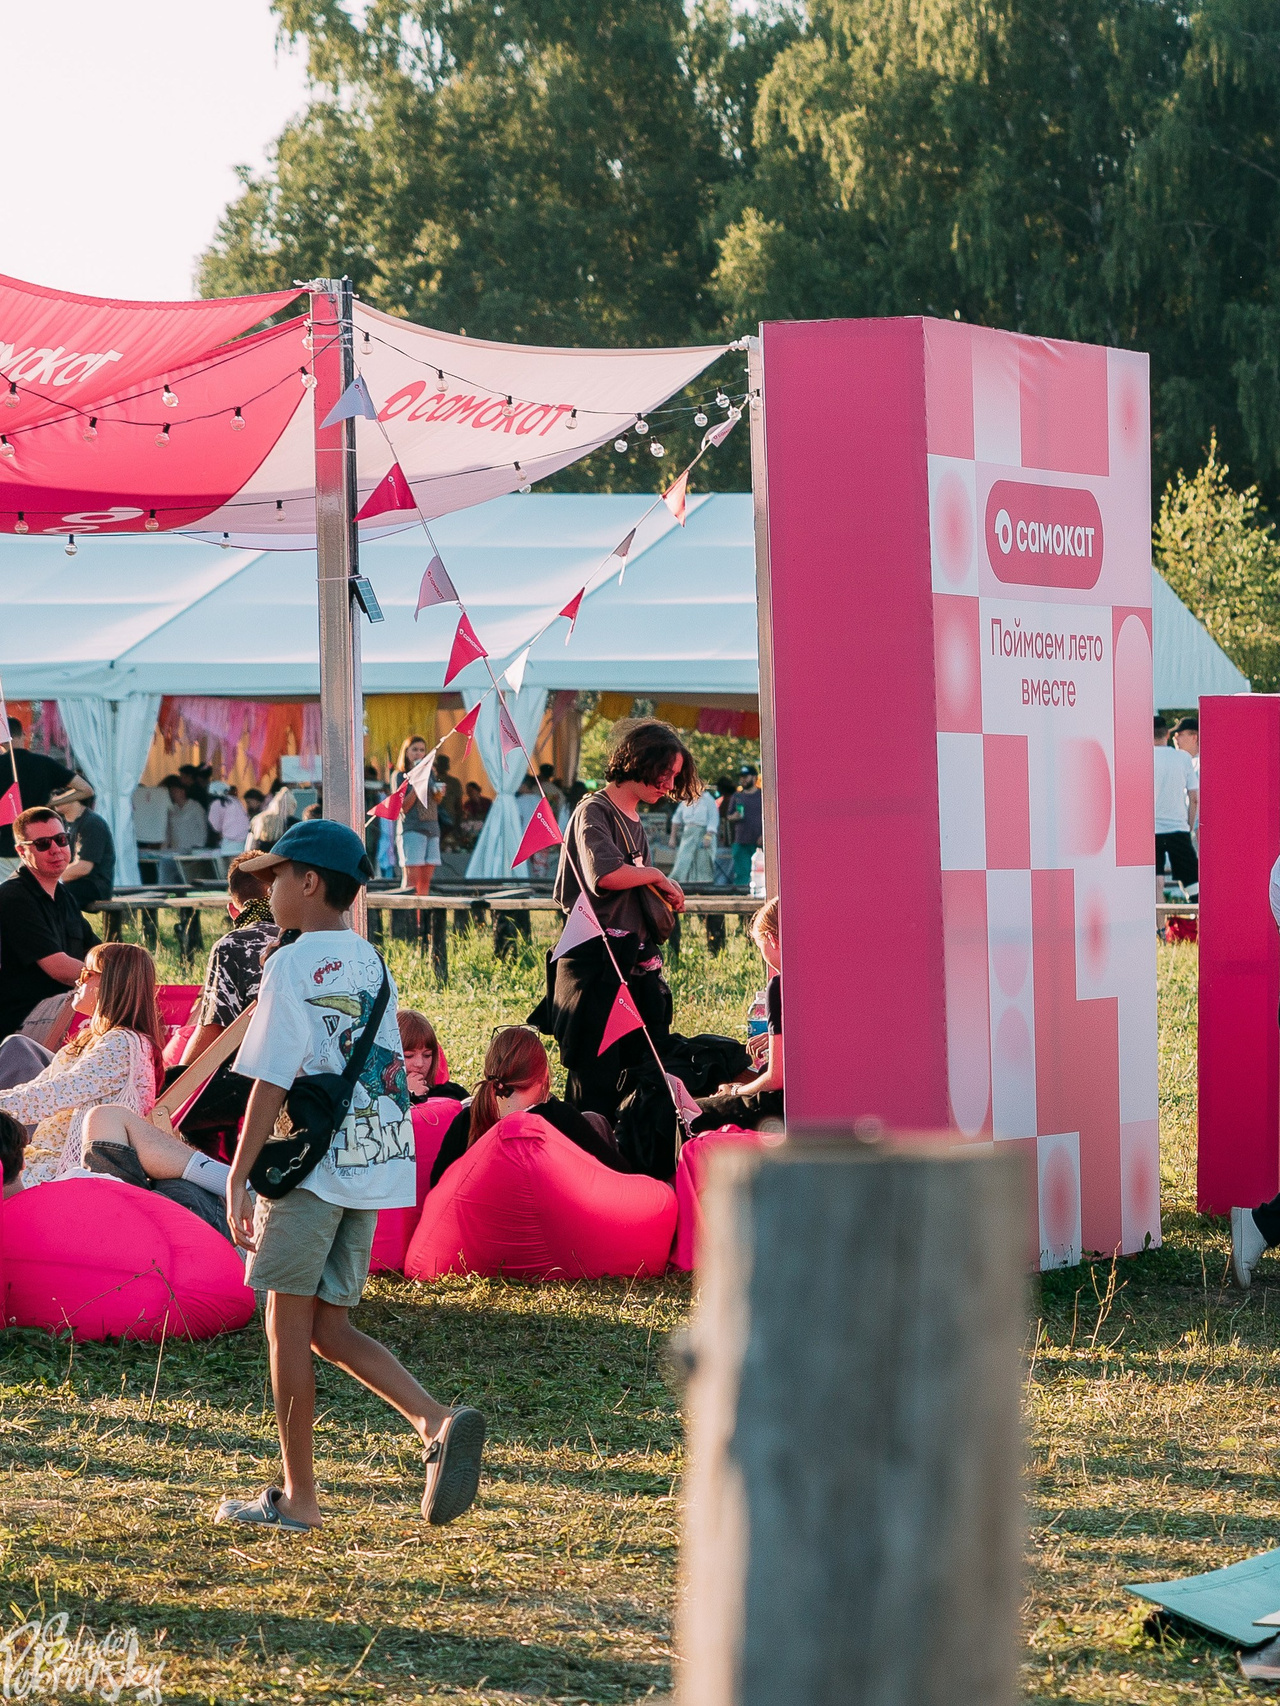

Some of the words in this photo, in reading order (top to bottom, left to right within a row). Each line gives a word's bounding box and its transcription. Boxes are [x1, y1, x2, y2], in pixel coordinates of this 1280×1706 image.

[407, 393, 575, 437] самокат
[1016, 519, 1095, 558] самокат
[990, 618, 1065, 660] Поймаем
[1068, 633, 1103, 662] лето
[1021, 678, 1077, 707] вместе
